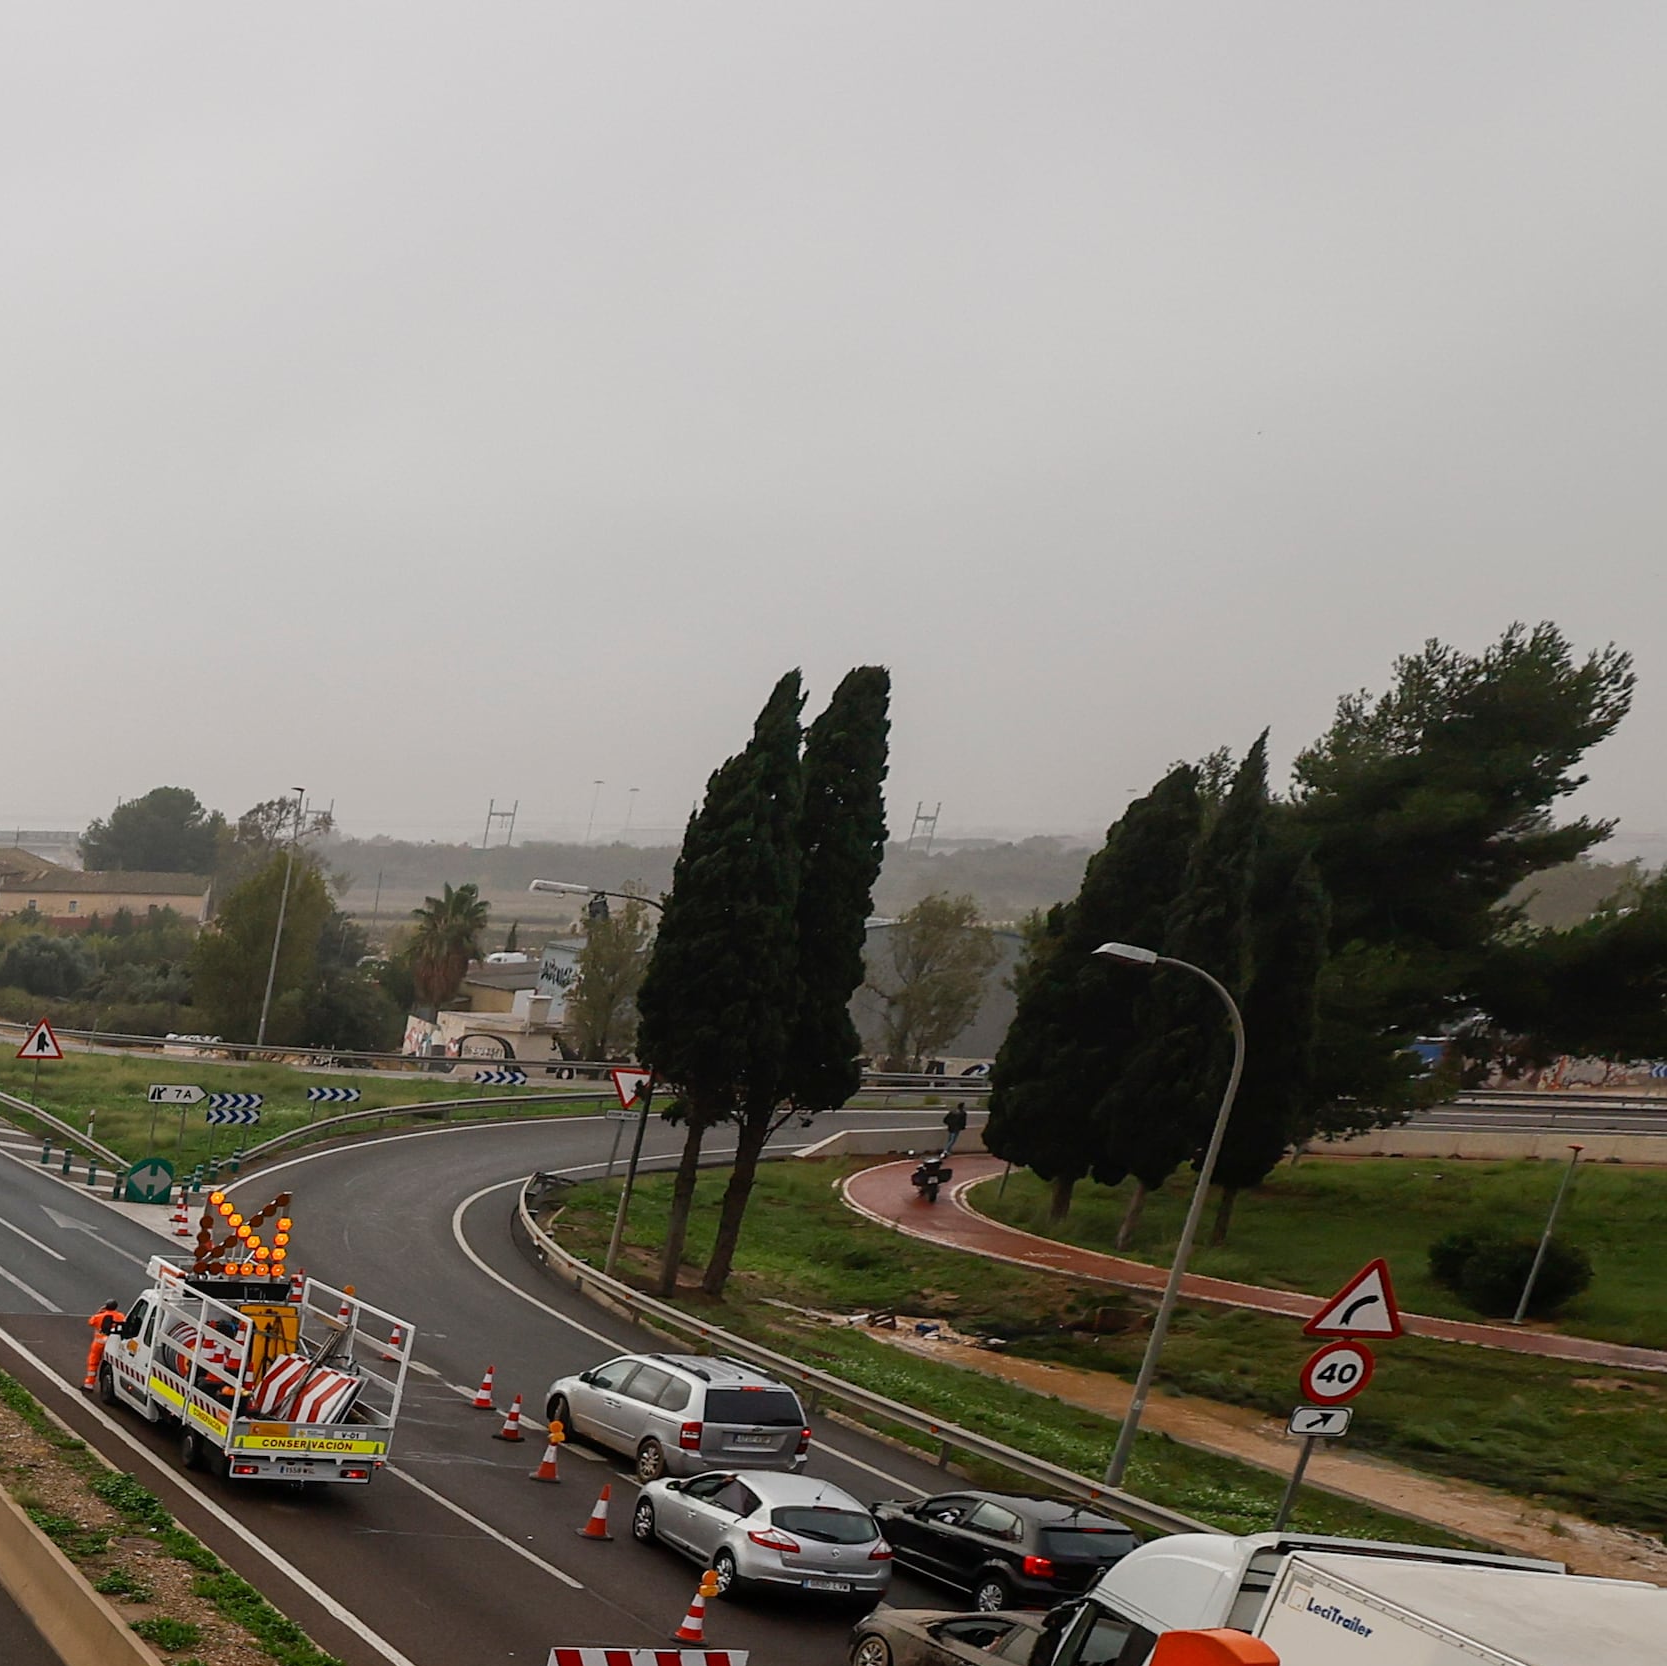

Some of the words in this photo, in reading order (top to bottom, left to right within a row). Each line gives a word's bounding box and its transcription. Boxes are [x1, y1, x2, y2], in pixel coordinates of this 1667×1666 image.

[1316, 1362, 1358, 1384] 40
[261, 1438, 353, 1451] CONSERVACIÓN
[1306, 1597, 1373, 1638] LeciTrailer
